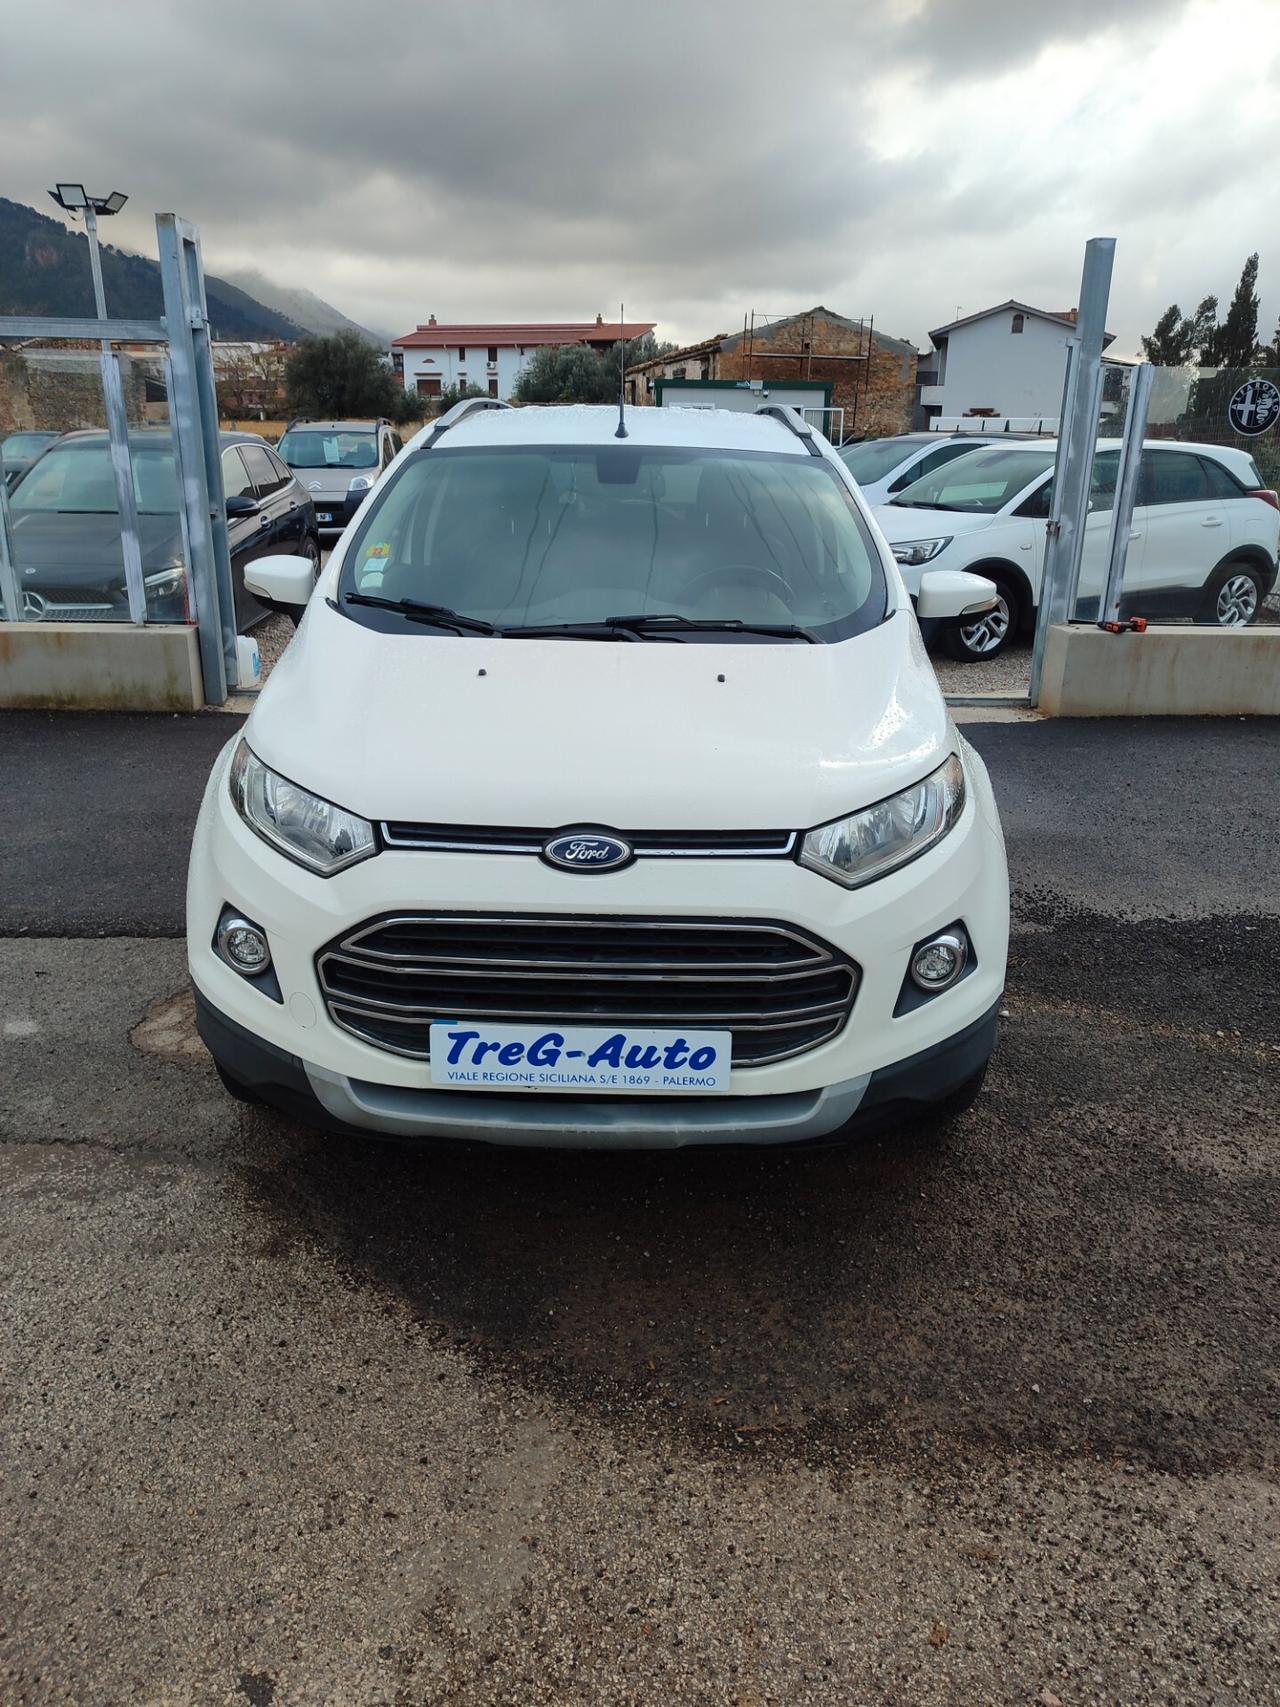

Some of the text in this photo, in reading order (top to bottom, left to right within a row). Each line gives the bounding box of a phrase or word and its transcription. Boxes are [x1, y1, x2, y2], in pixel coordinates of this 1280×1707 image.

[1231, 382, 1279, 412] ALFA ROMEO
[565, 841, 609, 860] Ford
[447, 1031, 716, 1070] TreG-Auto
[447, 1071, 478, 1081] VIALE
[482, 1072, 535, 1082] REGIONE
[539, 1073, 596, 1083] SICILIANA
[599, 1074, 618, 1085] S/E
[622, 1075, 650, 1085] 1869
[663, 1076, 717, 1087] PALERMO
